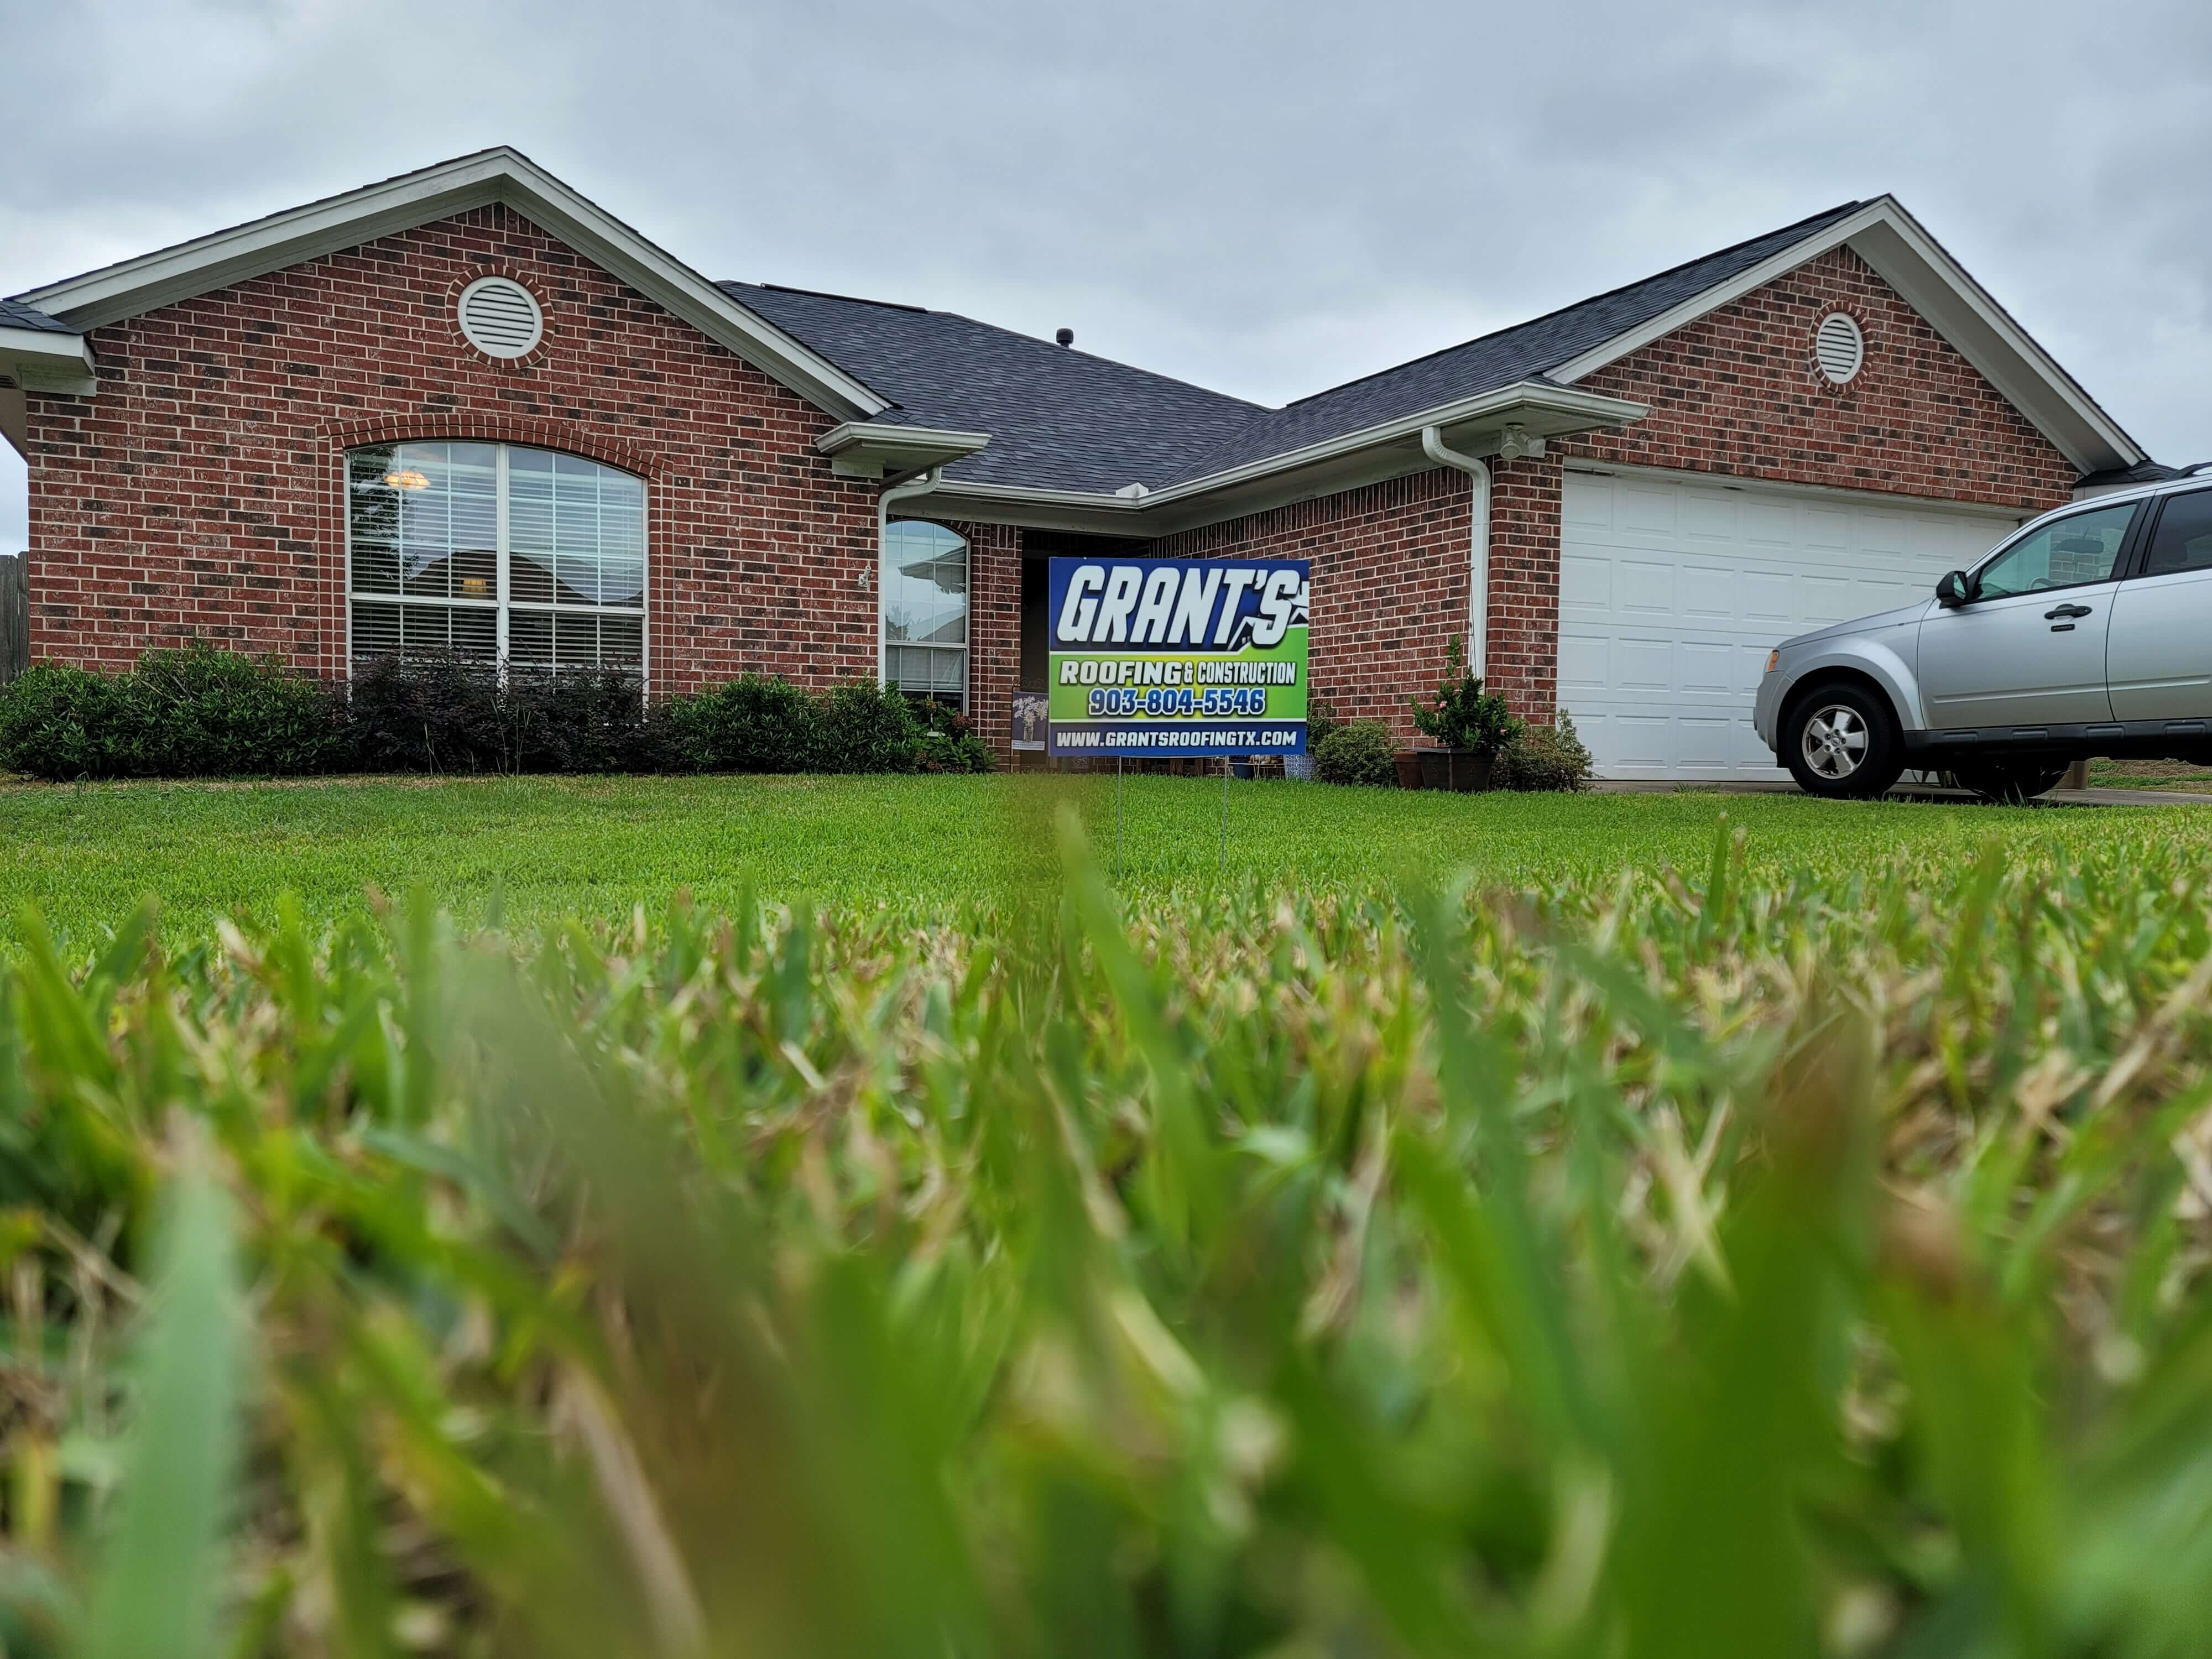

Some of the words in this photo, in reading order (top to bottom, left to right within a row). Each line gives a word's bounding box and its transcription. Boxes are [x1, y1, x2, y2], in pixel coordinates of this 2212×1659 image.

[1057, 565, 1300, 645] GRANT'S
[1060, 661, 1183, 685] ROOFING
[1184, 663, 1193, 682] &
[1198, 662, 1296, 684] CONSTRUCTION
[1089, 688, 1265, 716] 903-804-5546
[1057, 731, 1297, 747] WWW.GRANTSROOFINGTX.COM
